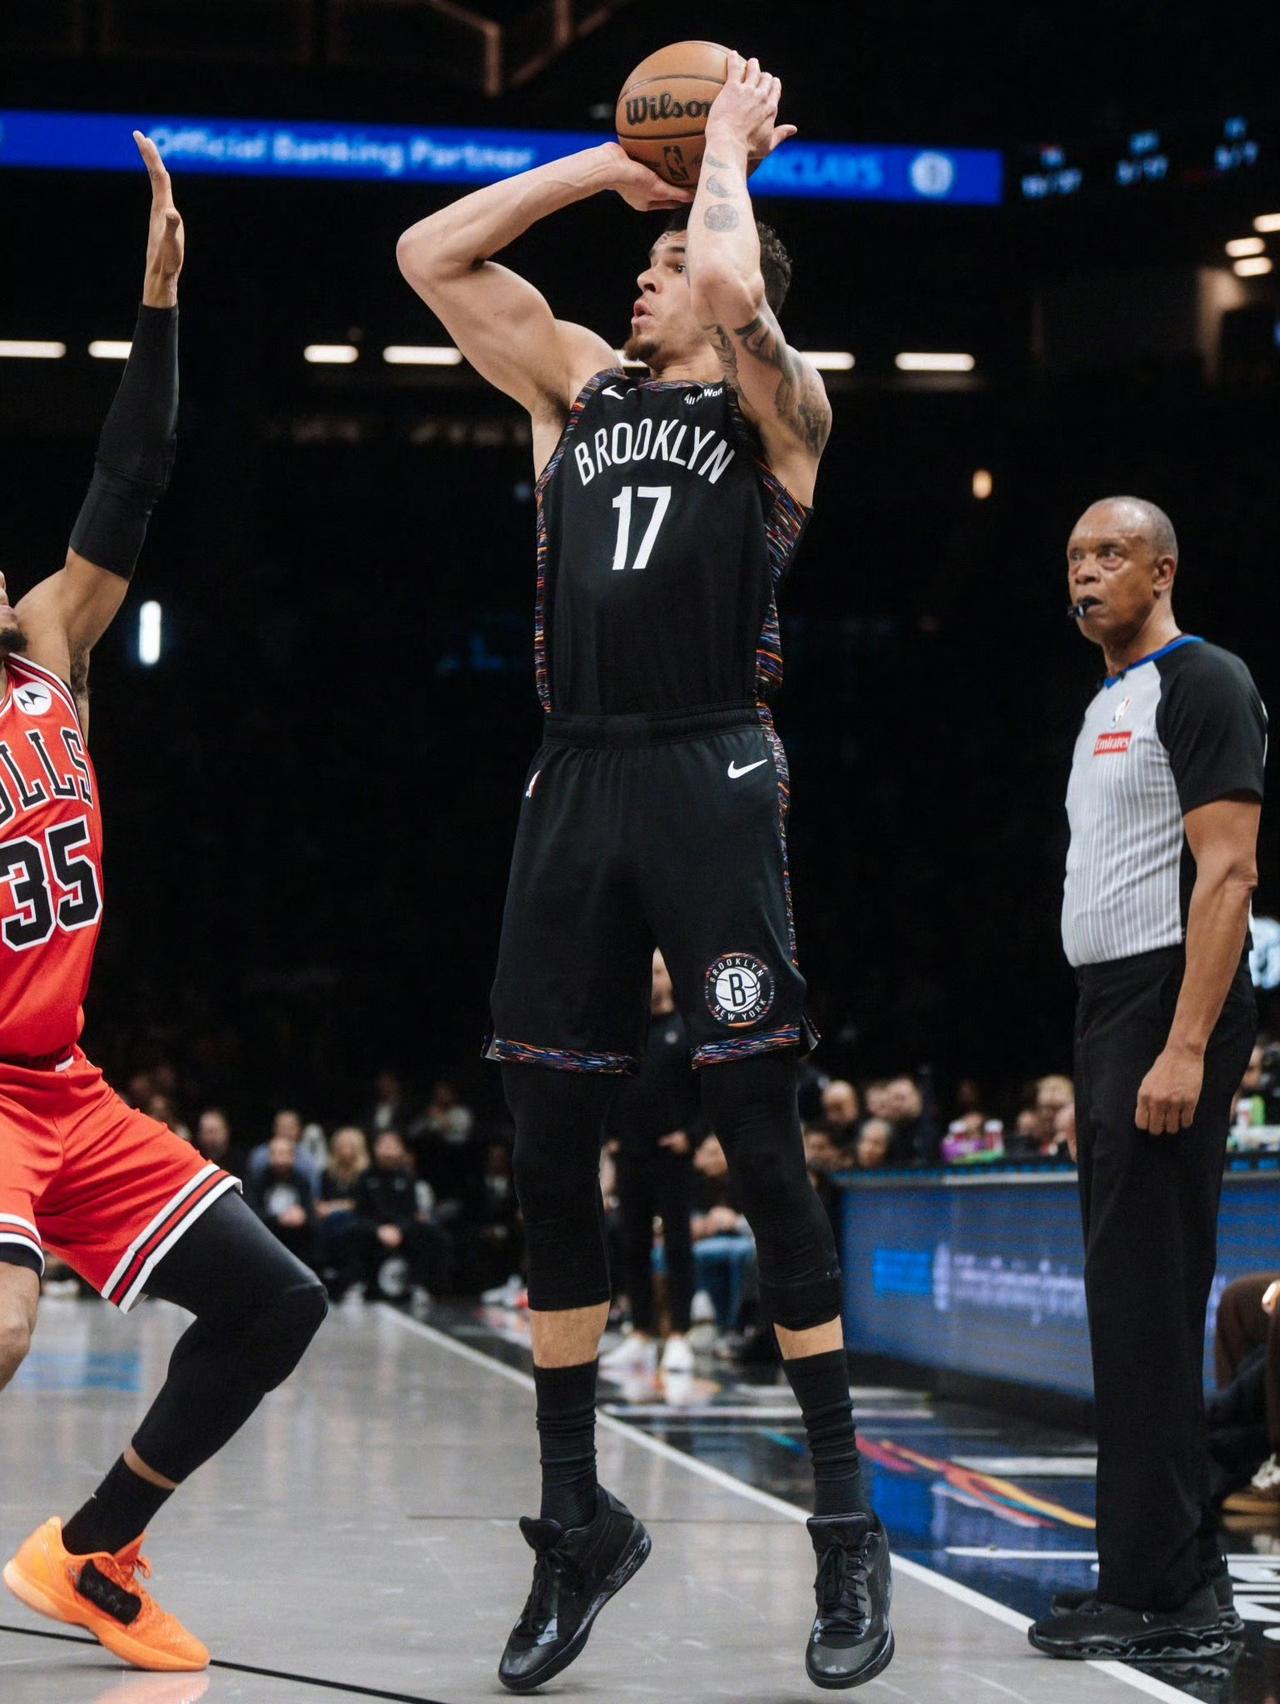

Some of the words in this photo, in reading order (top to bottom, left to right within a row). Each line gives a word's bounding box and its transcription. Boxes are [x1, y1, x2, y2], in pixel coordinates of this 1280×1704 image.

[147, 127, 268, 162] Official
[272, 131, 405, 175] Banking
[410, 137, 534, 171] Partner
[574, 417, 735, 487] BROOKLYN
[612, 486, 671, 570] 17
[0, 726, 93, 829] LLS
[0, 815, 103, 952] 35
[709, 958, 765, 983] BROOKLYN
[728, 973, 747, 1008] B
[714, 1004, 736, 1021] NEW
[741, 998, 768, 1021] YORK
